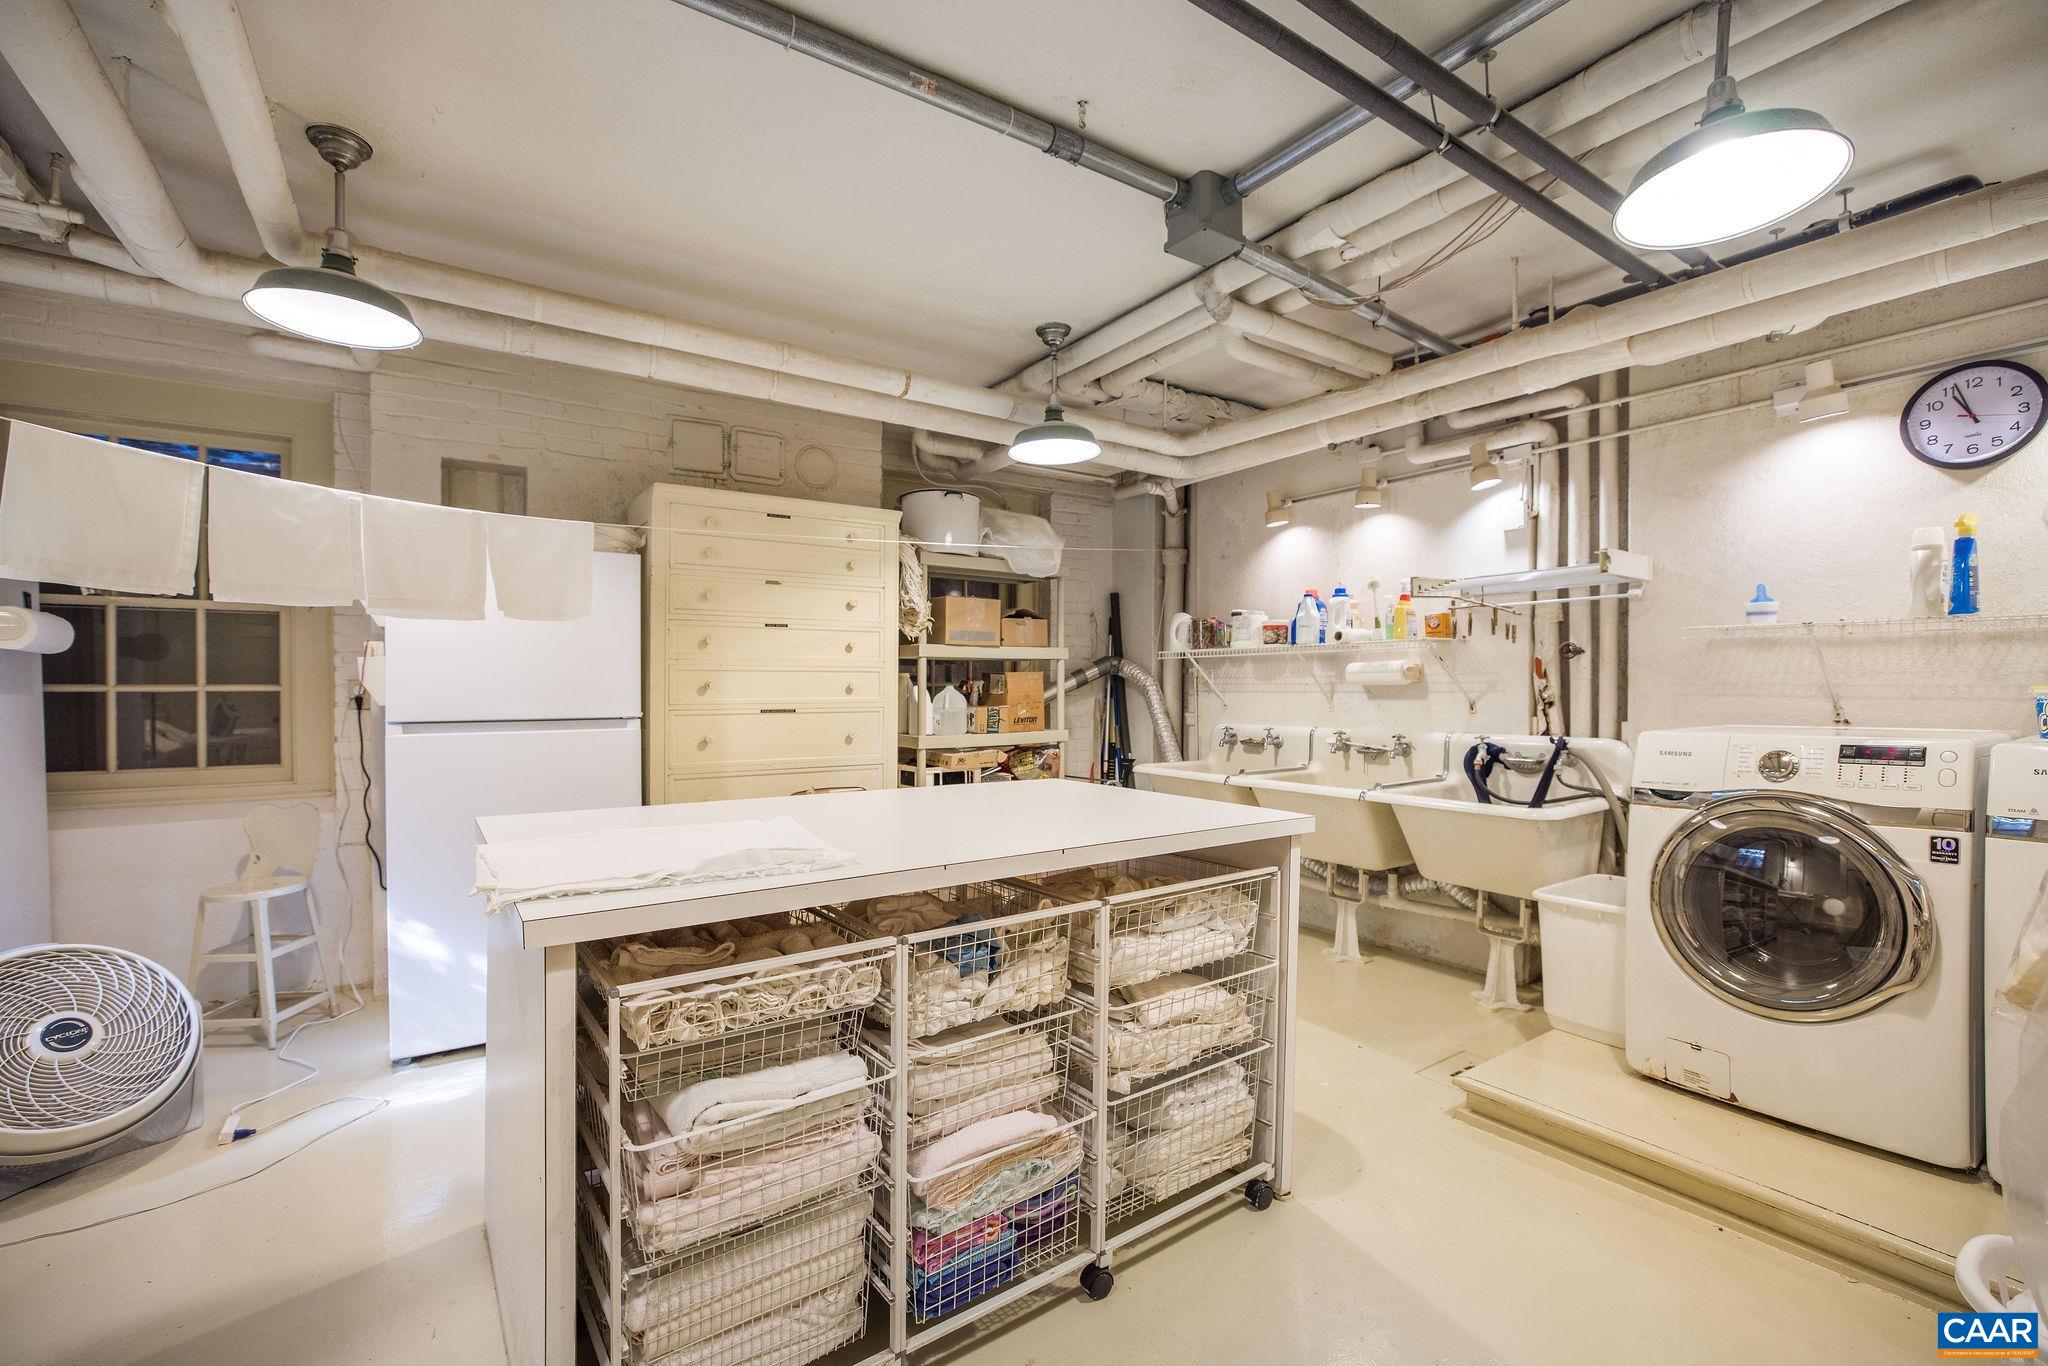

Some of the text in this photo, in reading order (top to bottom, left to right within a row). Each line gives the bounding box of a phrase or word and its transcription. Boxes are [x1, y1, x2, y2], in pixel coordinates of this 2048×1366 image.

[1965, 377, 1983, 389] 12
[1996, 377, 2002, 387] 1
[1943, 386, 1955, 397] 11
[2011, 385, 2023, 397] 2
[1926, 400, 1944, 412] 10
[2018, 402, 2031, 413] 3
[1919, 419, 1931, 430] 9
[2009, 421, 2022, 431] 4
[1927, 435, 1938, 445] 8
[1991, 436, 2004, 447] 5
[1944, 443, 1953, 454] 7
[1967, 444, 1979, 454] 6
[1013, 716, 1038, 724] LEVITON
[1933, 838, 1956, 850] 10
